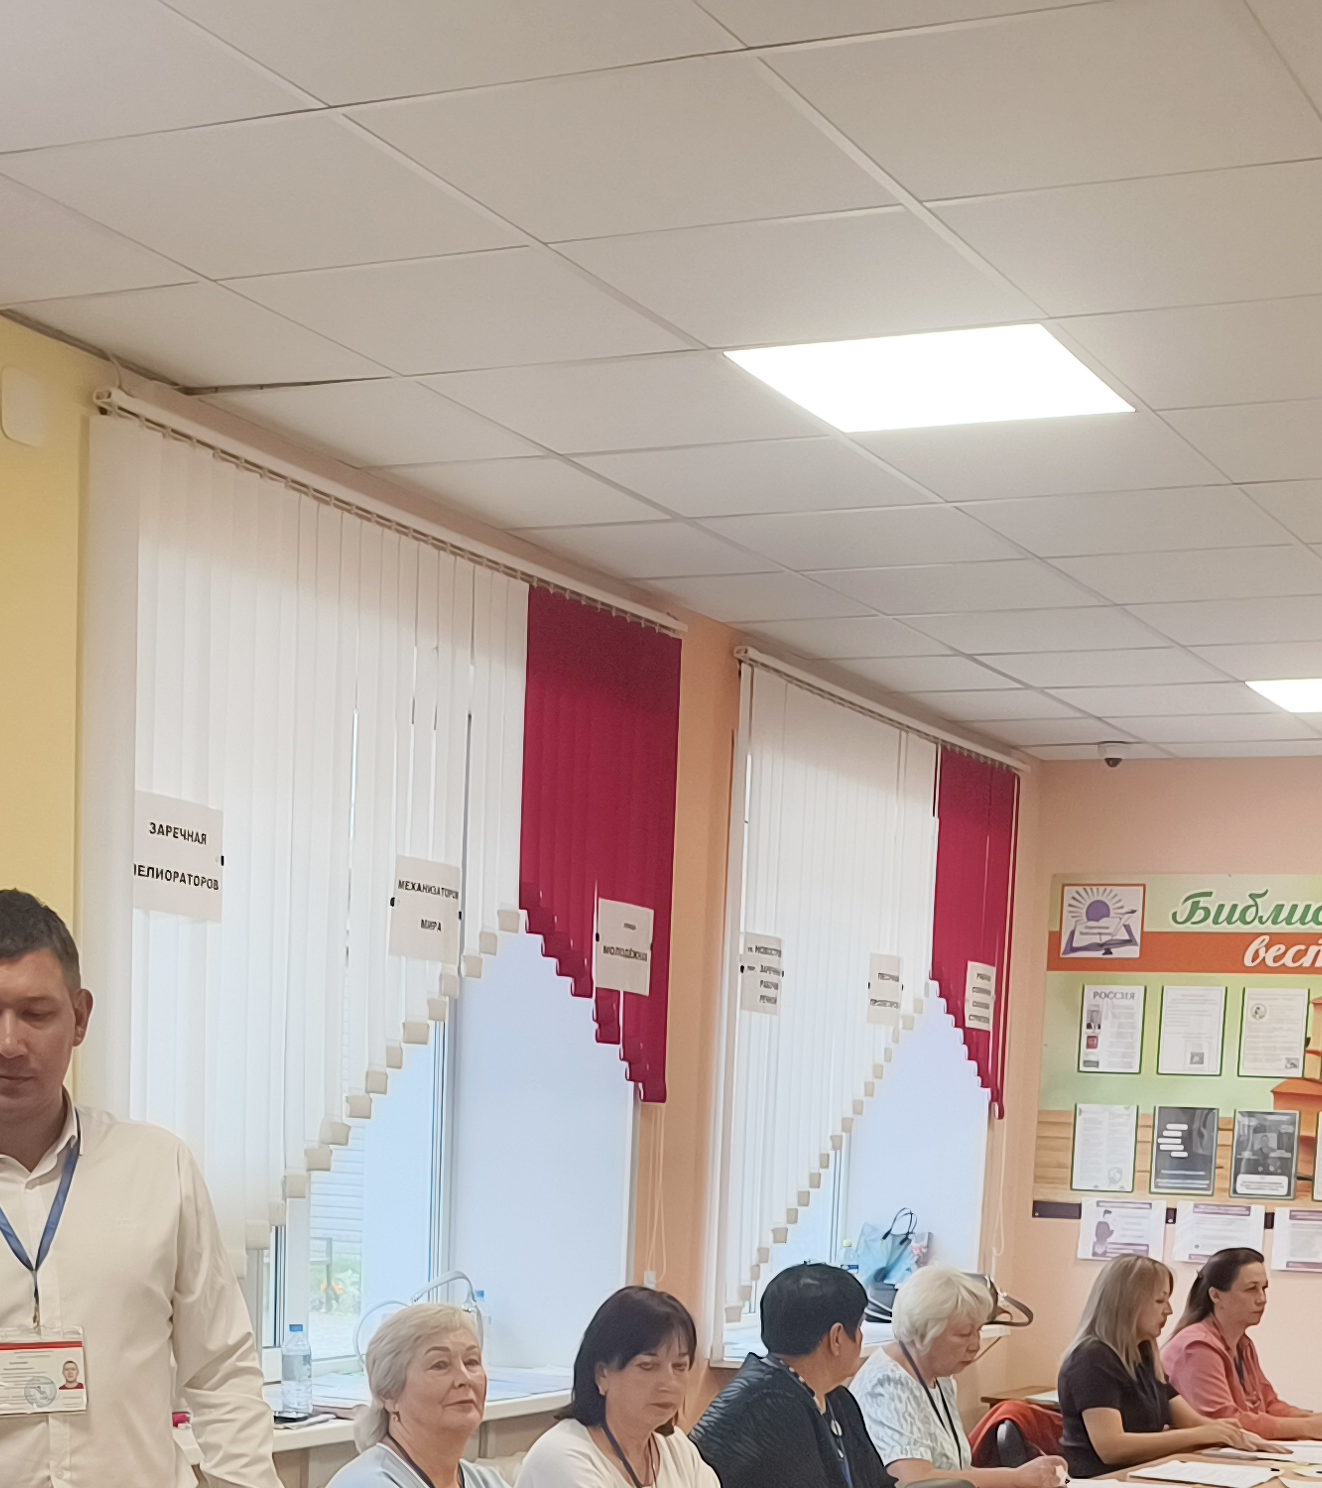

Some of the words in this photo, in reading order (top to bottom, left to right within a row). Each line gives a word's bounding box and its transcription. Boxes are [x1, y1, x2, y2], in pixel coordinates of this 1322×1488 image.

[148, 822, 207, 845] ЗАРЕЧНАЯ
[420, 919, 442, 932] МИРА
[1093, 991, 1136, 1001] РОССИЯ
